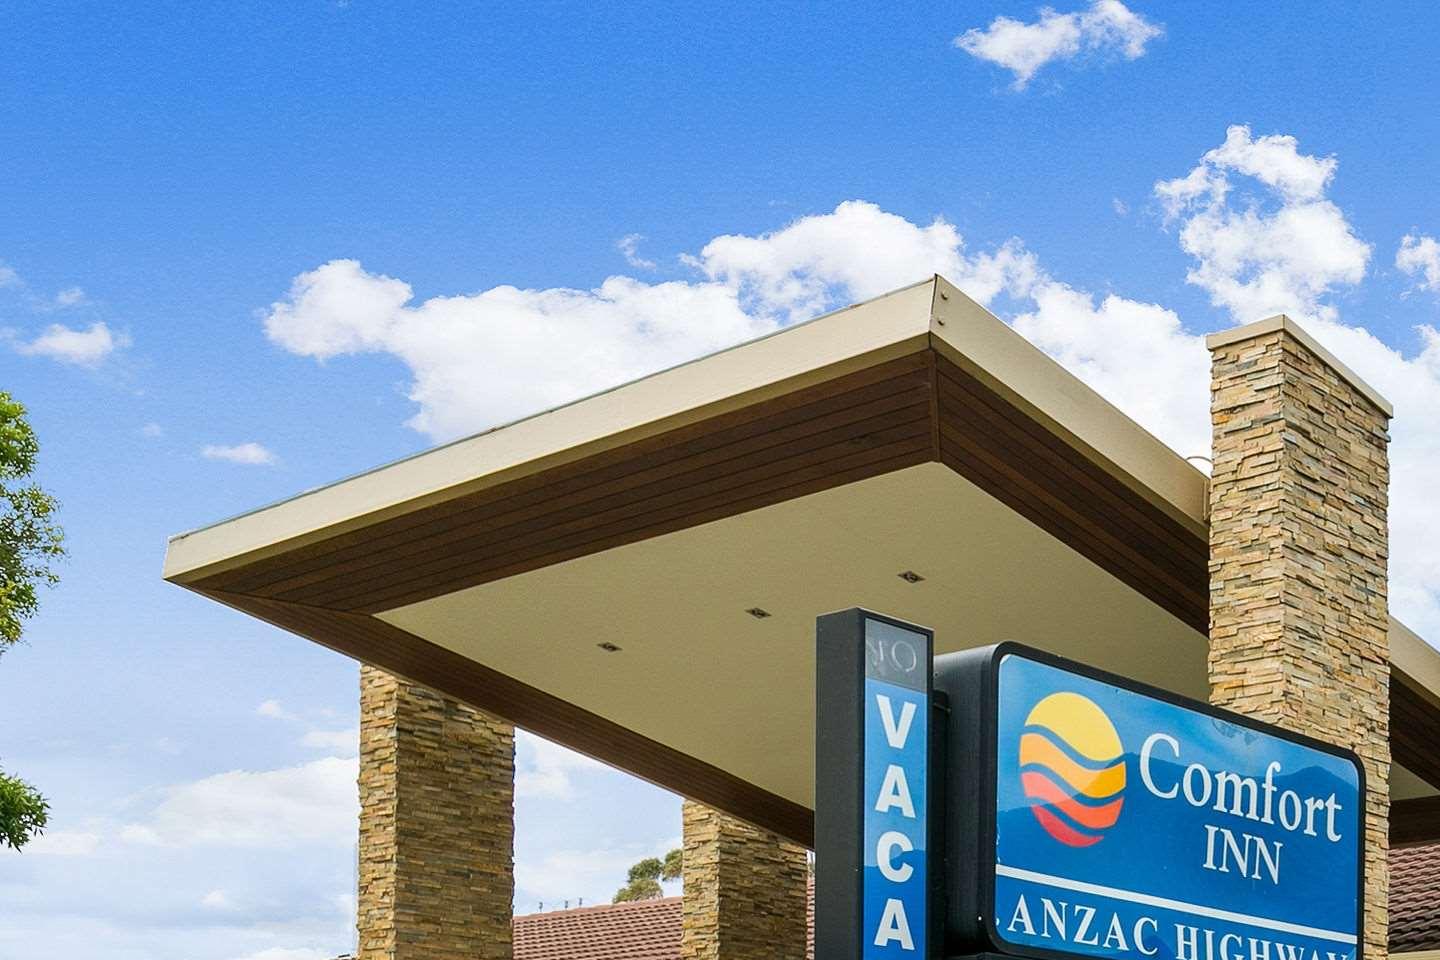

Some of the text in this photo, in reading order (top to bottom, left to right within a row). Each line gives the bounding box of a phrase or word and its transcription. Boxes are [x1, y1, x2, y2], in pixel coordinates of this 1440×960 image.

[1139, 732, 1343, 842] Comfort
[1202, 824, 1283, 885] INN
[1007, 893, 1158, 955] ANZAC
